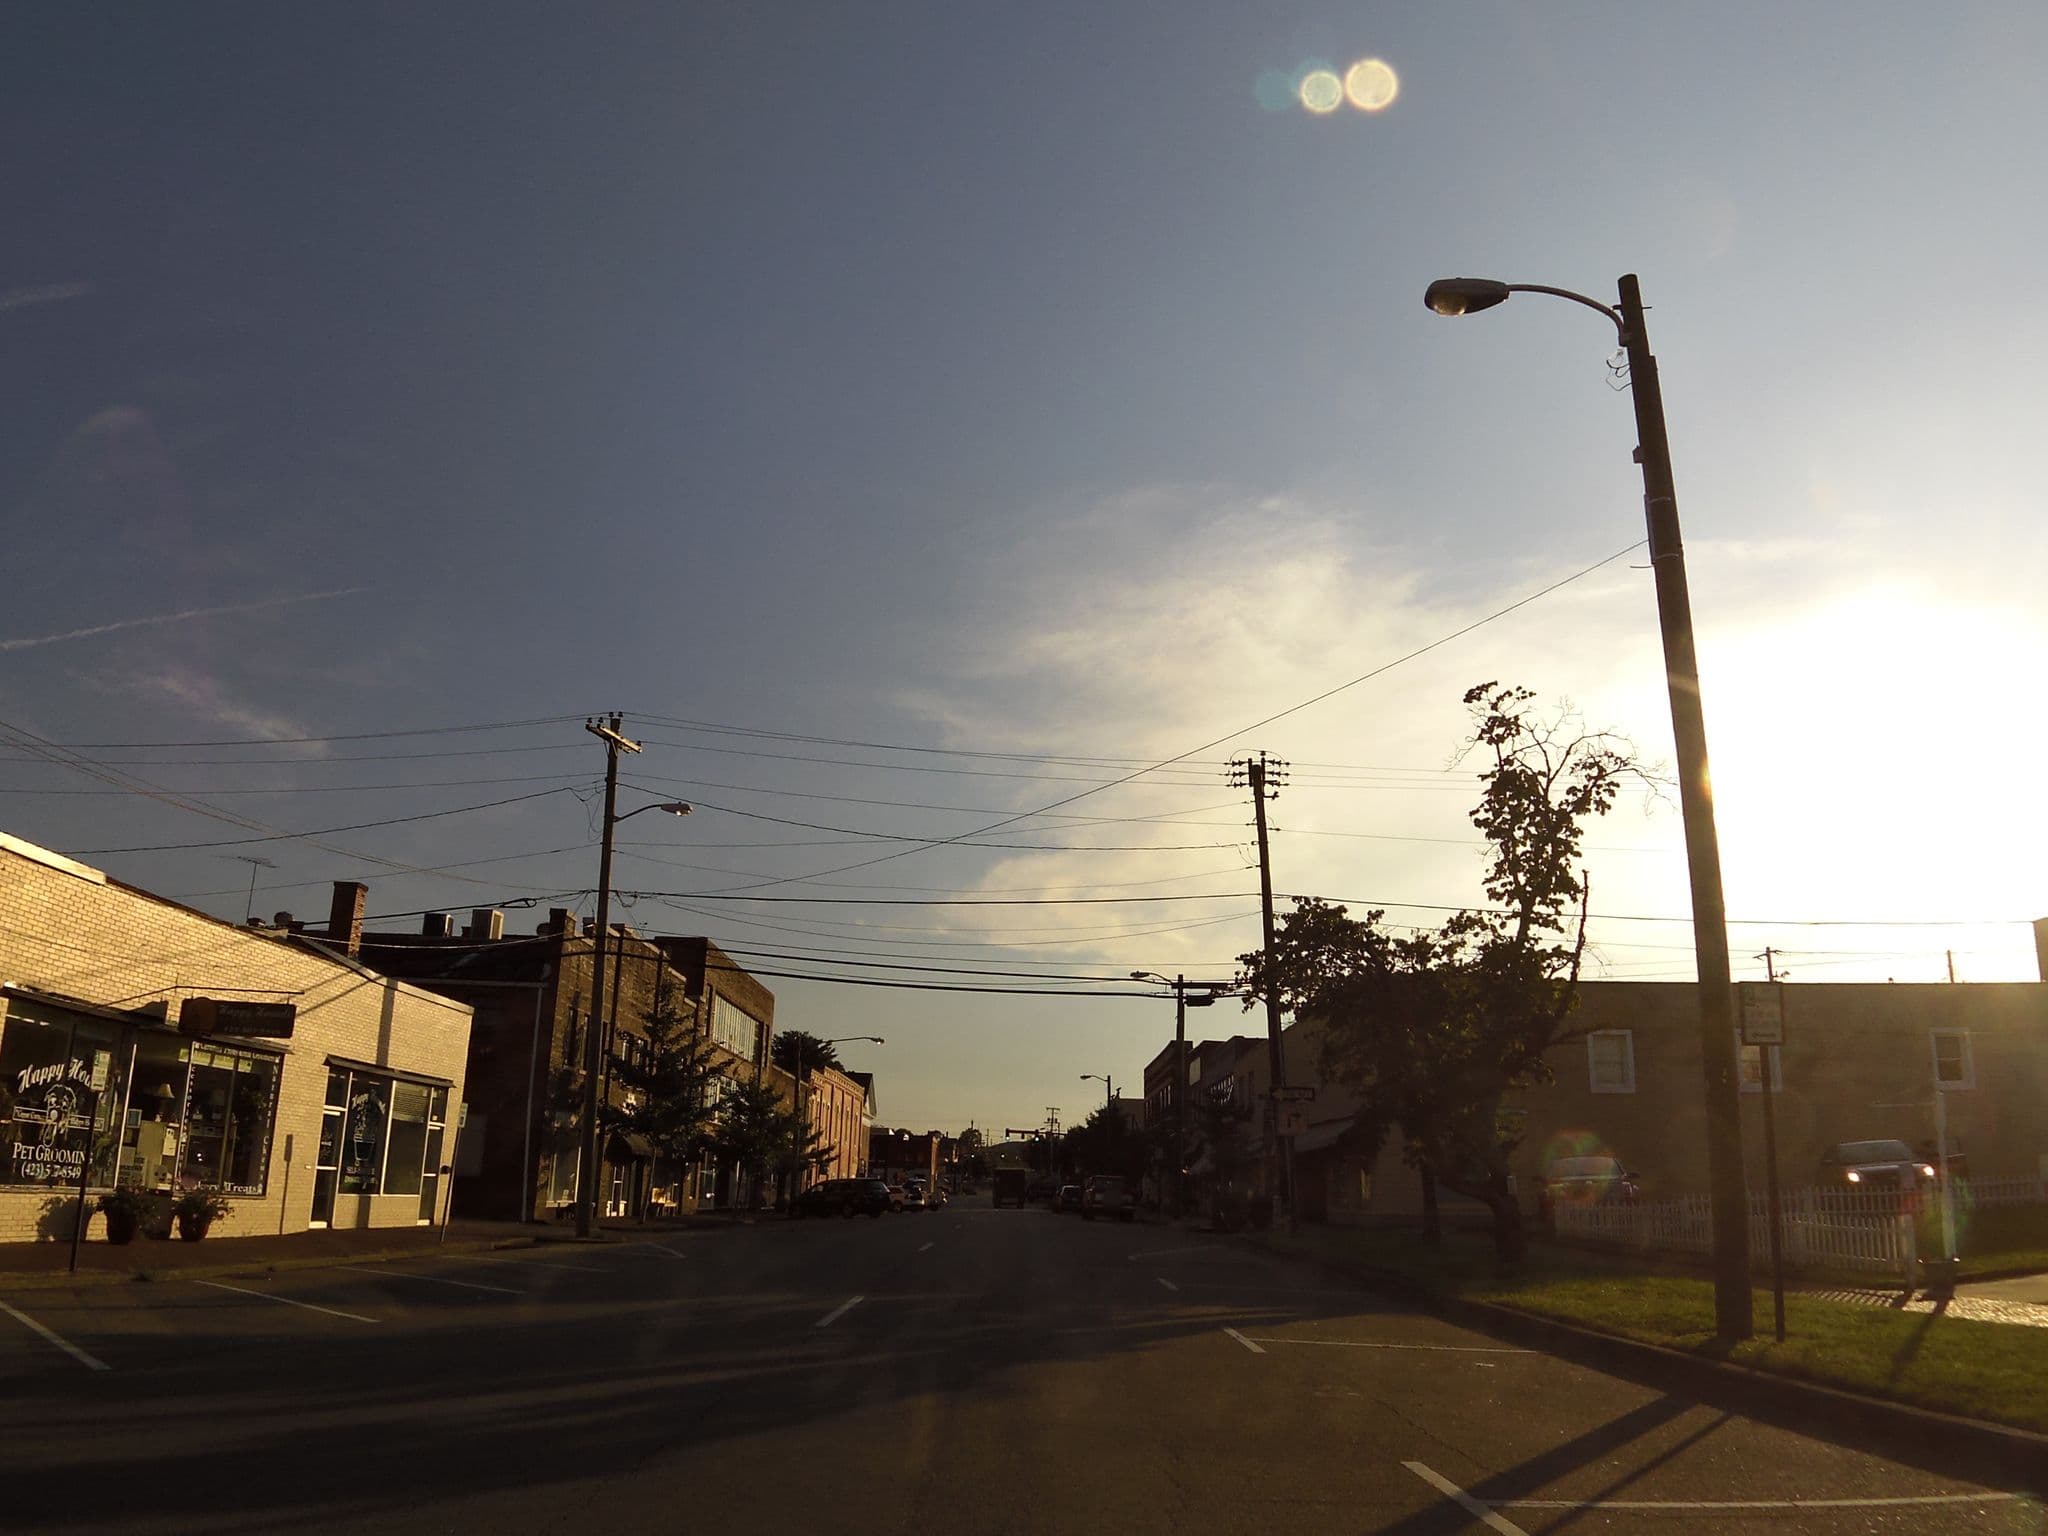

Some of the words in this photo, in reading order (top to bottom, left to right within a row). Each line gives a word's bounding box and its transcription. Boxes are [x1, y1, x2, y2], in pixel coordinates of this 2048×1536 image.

[17, 1063, 65, 1093] Happy
[67, 1057, 92, 1088] Hou
[12, 1142, 36, 1160] PET
